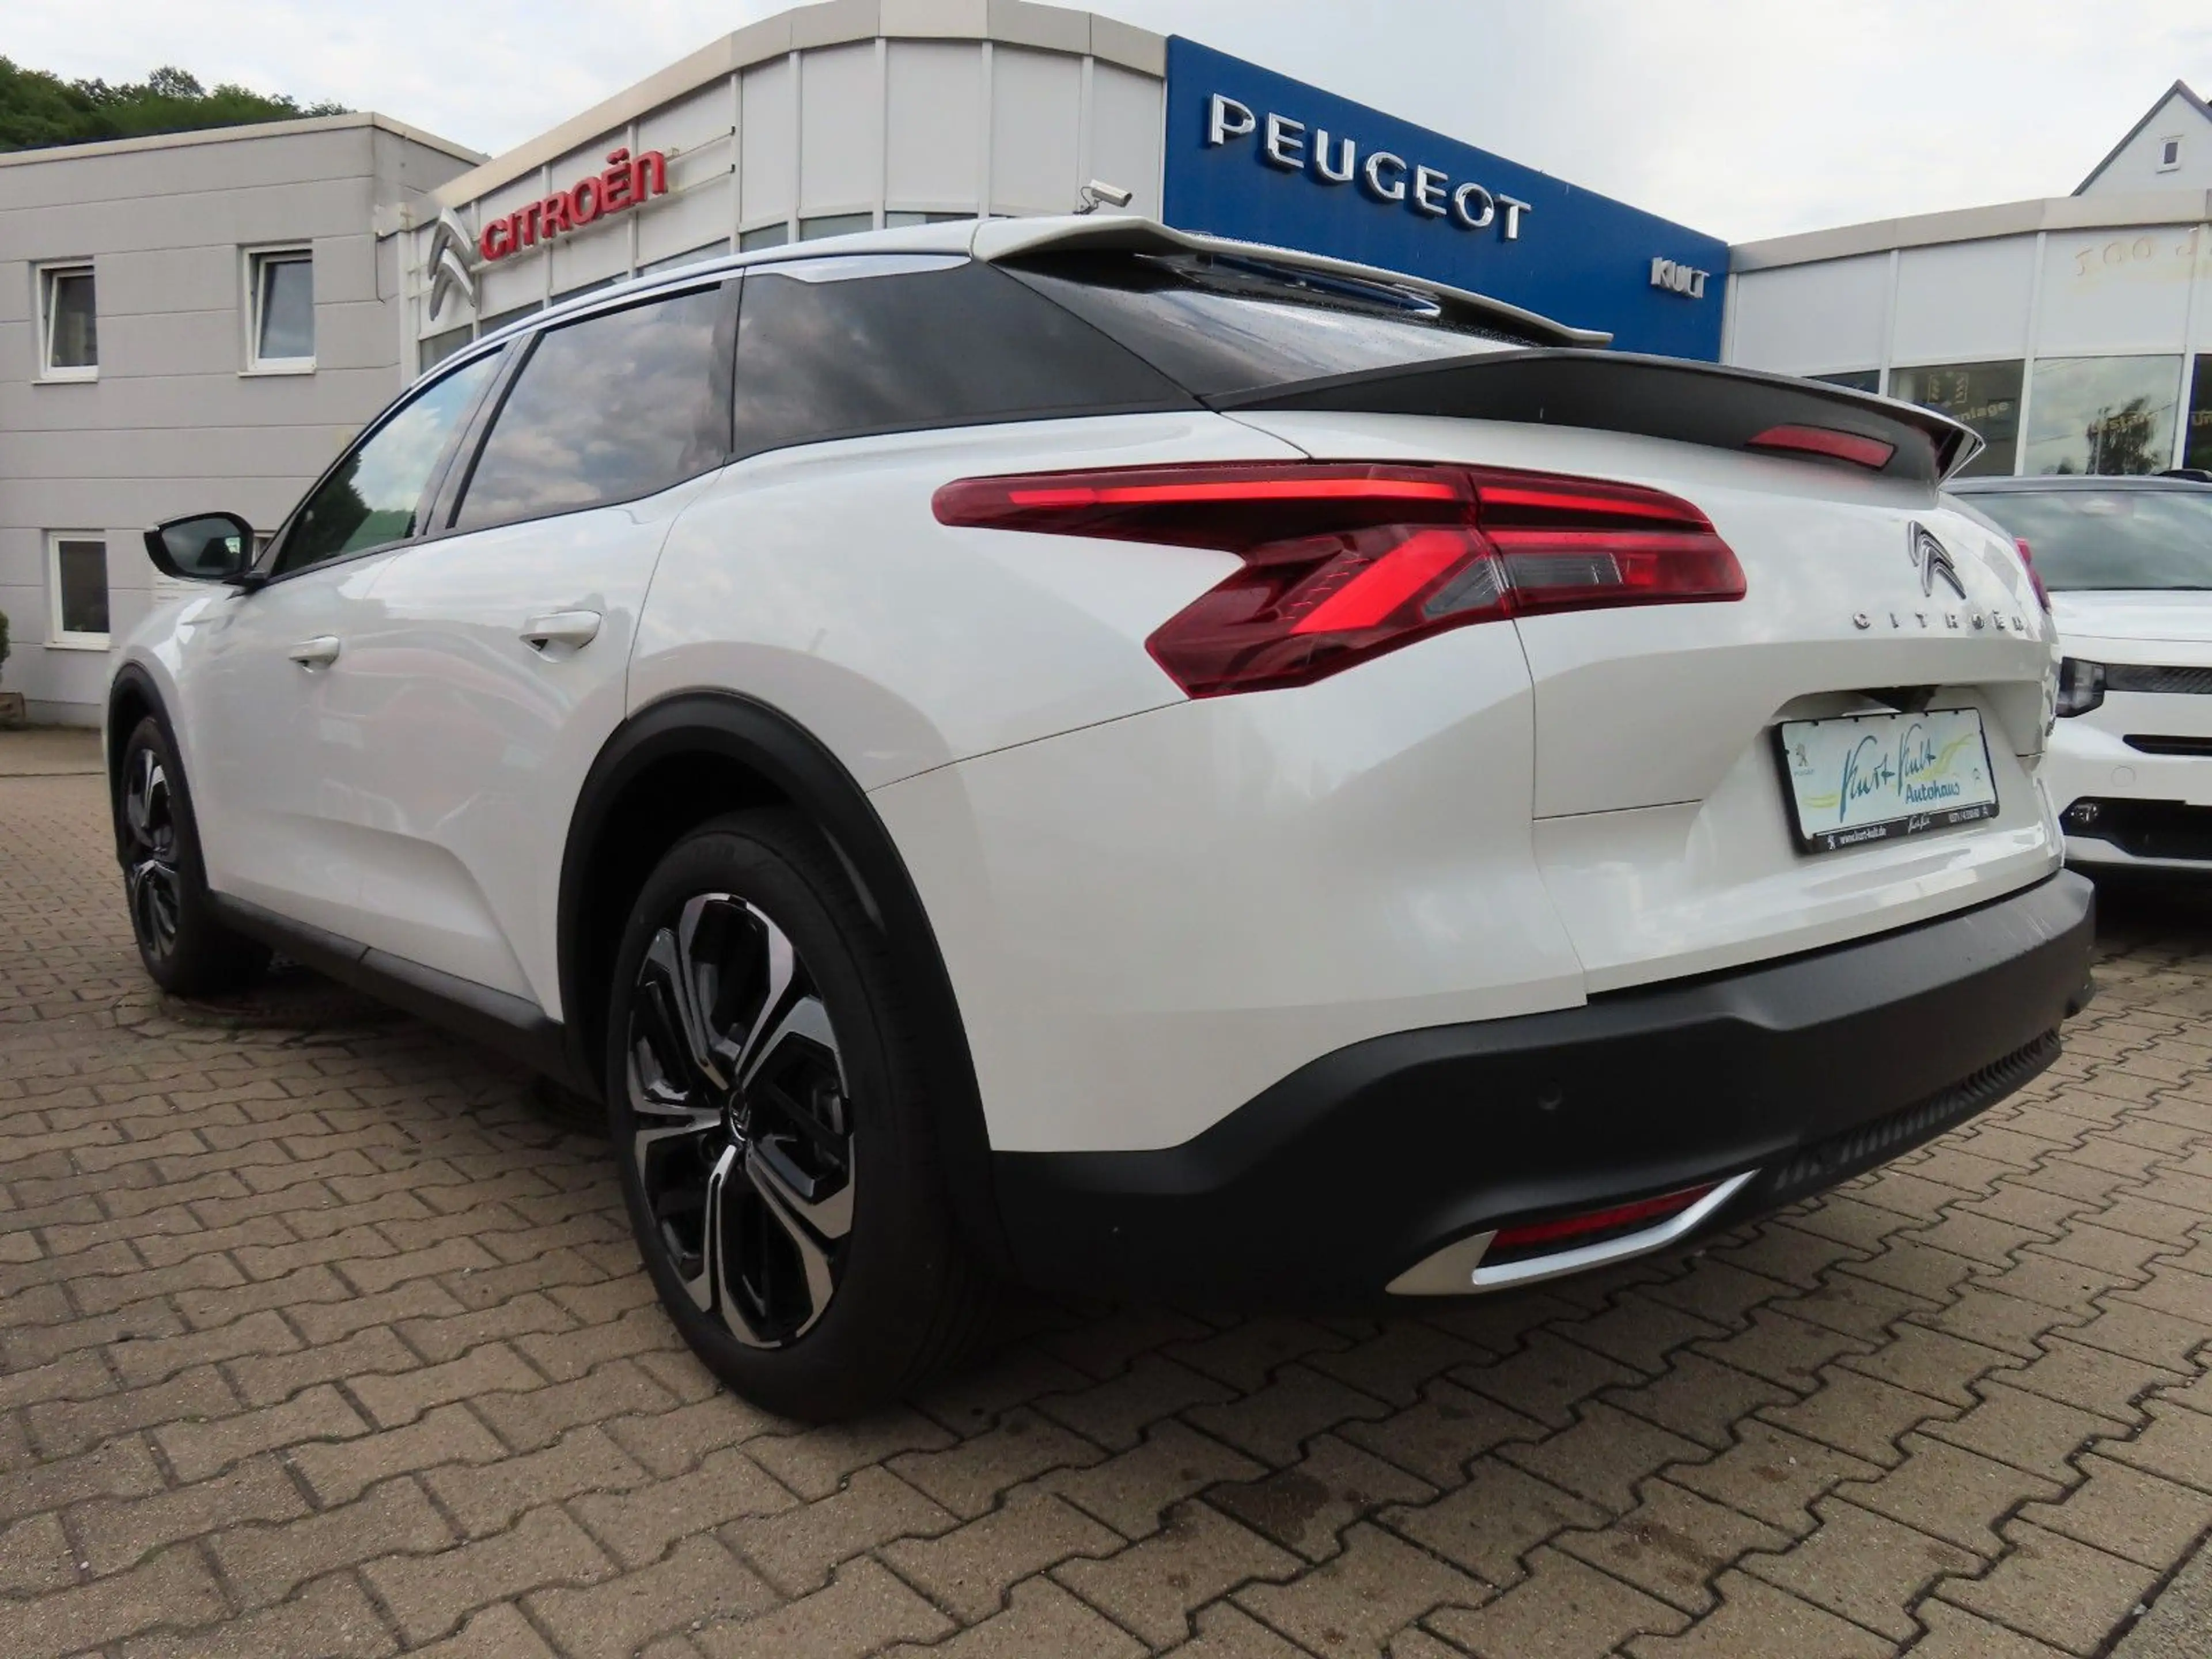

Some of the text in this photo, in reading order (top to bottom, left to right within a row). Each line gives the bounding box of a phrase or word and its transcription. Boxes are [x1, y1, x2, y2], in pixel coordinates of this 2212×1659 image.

[1207, 93, 1532, 240] PEUGEOT
[1651, 257, 1710, 298] KULT
[1905, 780, 1960, 804] Autohaus
